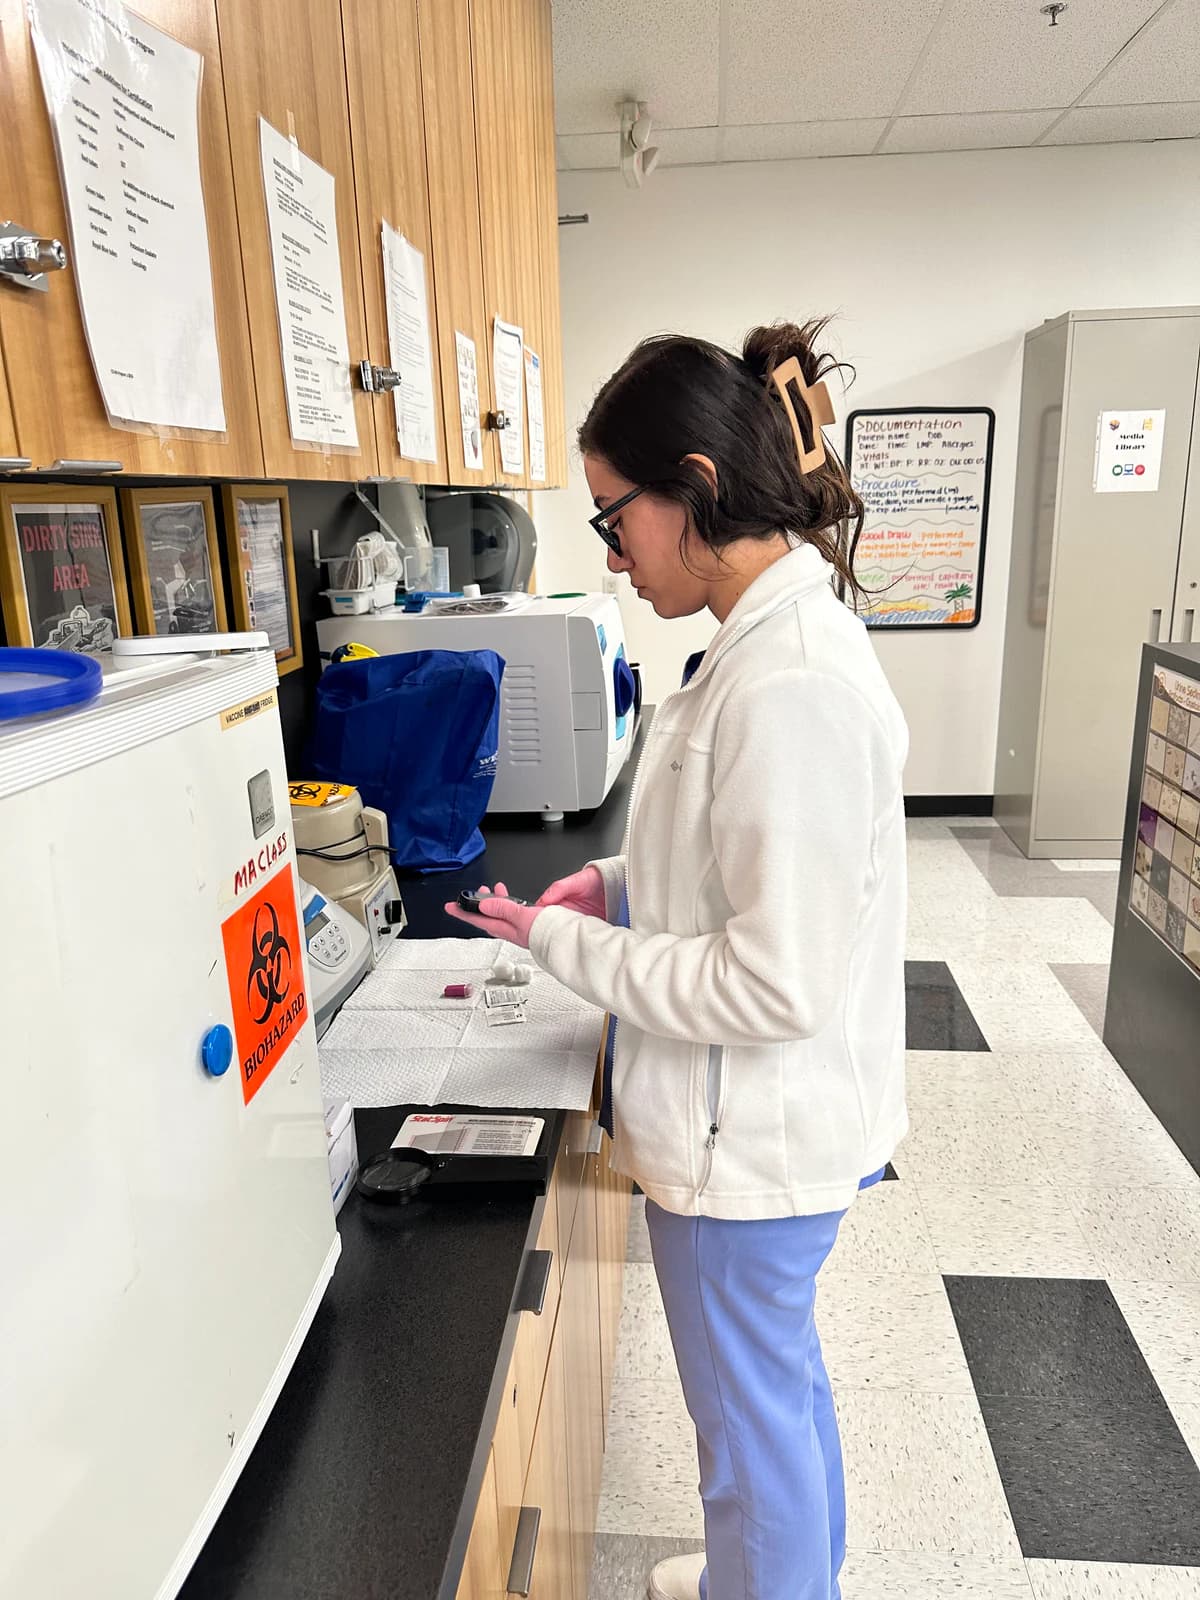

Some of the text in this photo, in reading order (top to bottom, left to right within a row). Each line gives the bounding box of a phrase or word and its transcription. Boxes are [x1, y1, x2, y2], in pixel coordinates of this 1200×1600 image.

[22, 524, 68, 553] DIRTY
[53, 563, 91, 592] AREA
[244, 991, 305, 1082] BIOHAZARD
